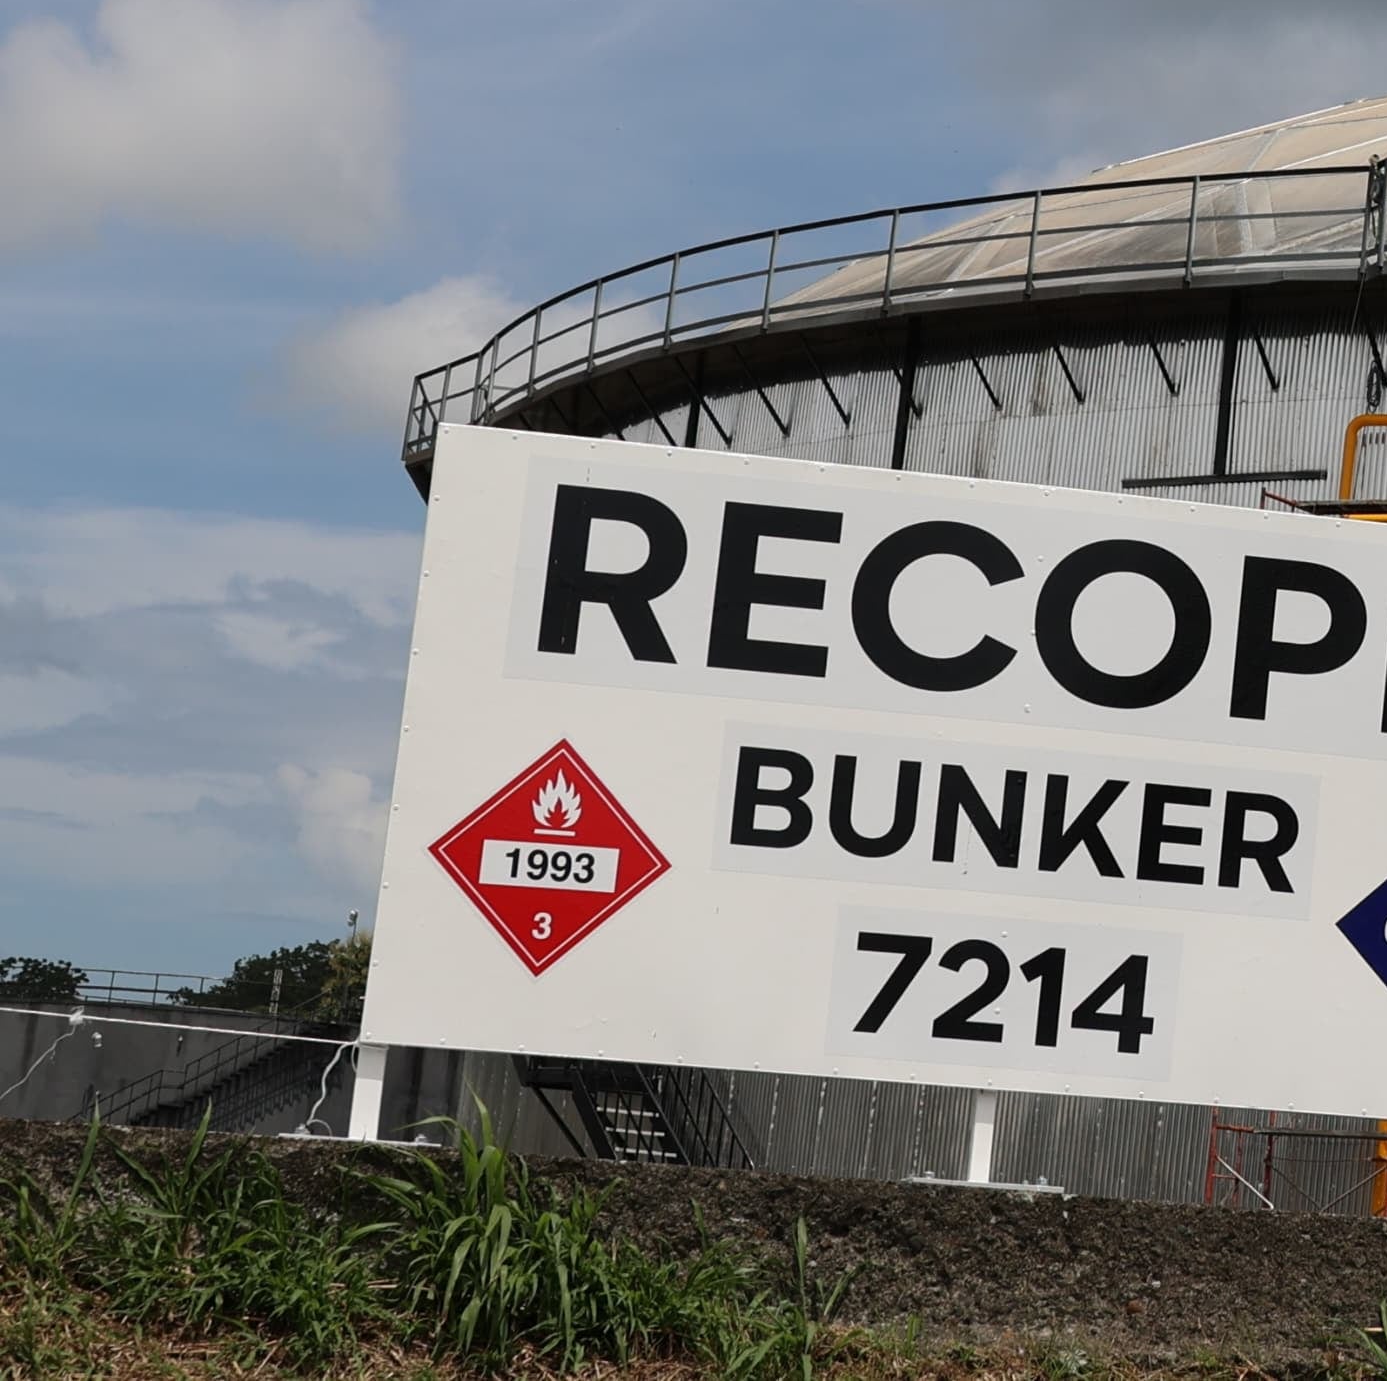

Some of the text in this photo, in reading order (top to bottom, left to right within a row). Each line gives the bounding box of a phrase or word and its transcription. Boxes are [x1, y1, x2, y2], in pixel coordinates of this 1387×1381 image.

[729, 745, 1300, 894] BUNKER
[505, 847, 595, 884] 1993
[531, 912, 552, 940] 3
[852, 931, 1155, 1055] 7214
